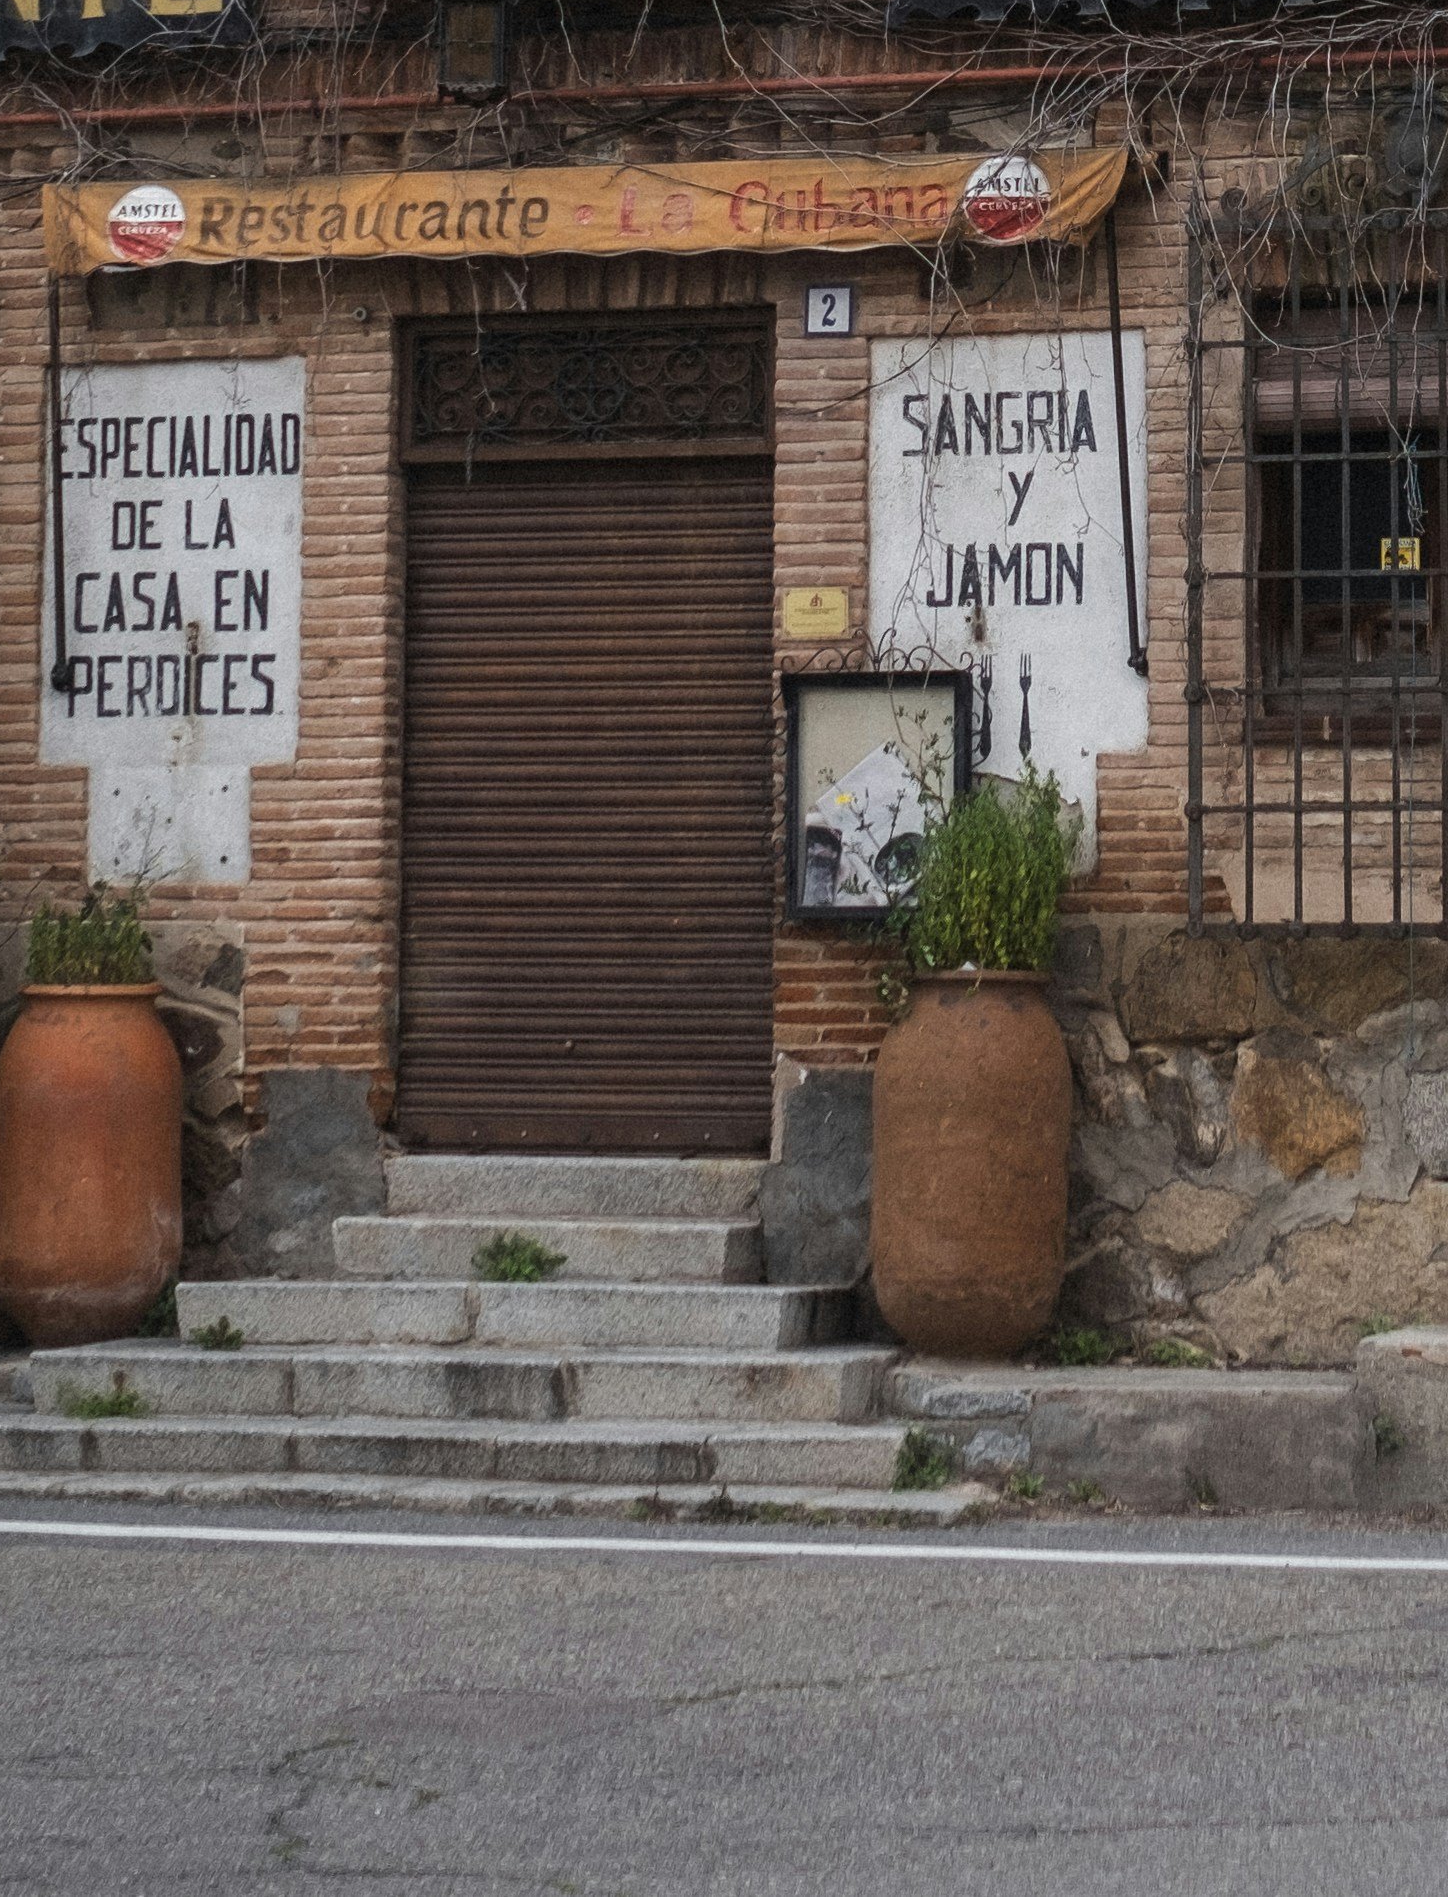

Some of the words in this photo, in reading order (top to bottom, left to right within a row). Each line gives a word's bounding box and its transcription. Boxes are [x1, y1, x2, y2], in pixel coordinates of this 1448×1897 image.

[116, 204, 177, 218] AMSTEL
[117, 225, 168, 236] CERVEZA
[198, 184, 549, 246] Restaurante
[617, 185, 695, 237] La
[728, 177, 950, 234] Cubana
[821, 293, 837, 327] 2
[56, 413, 301, 479] ESPECIALIDAD
[902, 390, 1098, 456] SANGRIA
[111, 499, 163, 550] DE
[184, 497, 236, 550] LA
[1008, 471, 1035, 526] Y
[73, 571, 183, 634] CASA
[213, 569, 269, 633] EN
[926, 542, 1084, 607] JAMON
[67, 653, 276, 719] PERDICES
